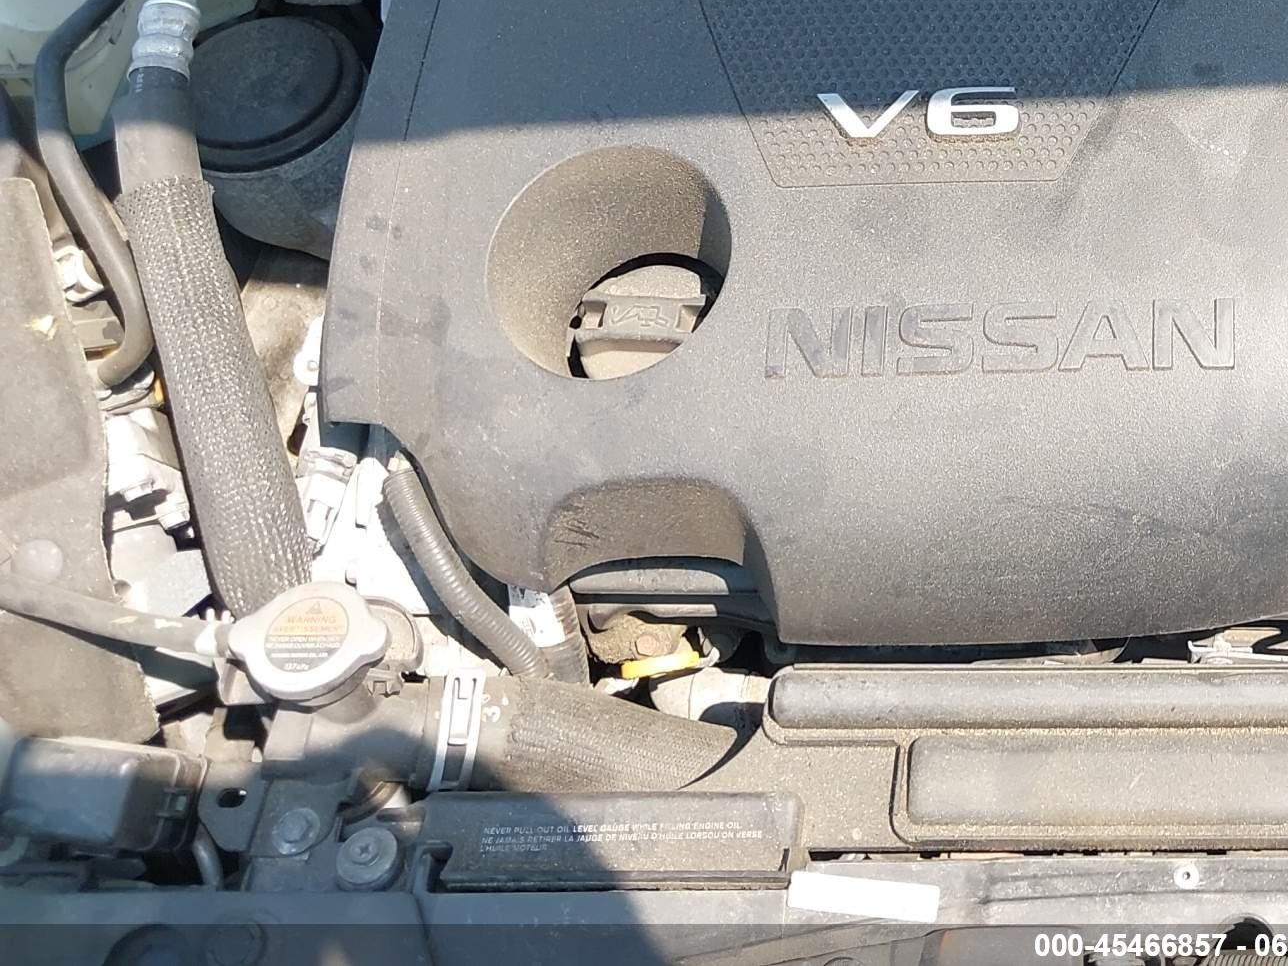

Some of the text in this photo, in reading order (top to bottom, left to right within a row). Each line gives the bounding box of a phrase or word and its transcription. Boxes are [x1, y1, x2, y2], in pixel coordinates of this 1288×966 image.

[817, 86, 1020, 141] V6
[765, 297, 1236, 378] NISSAN
[287, 616, 336, 624] WARNING
[483, 826, 511, 834] NEVER
[514, 826, 534, 834] PULL
[537, 826, 554, 834] OUT
[557, 825, 569, 834] OIL
[573, 824, 598, 832] LEVEL
[600, 823, 630, 832] GAUGE
[693, 822, 724, 830] ENGINE
[564, 834, 574, 842] LA
[576, 834, 603, 842] JAUGE
[606, 833, 616, 841] DE
[736, 830, 762, 838] VERSE
